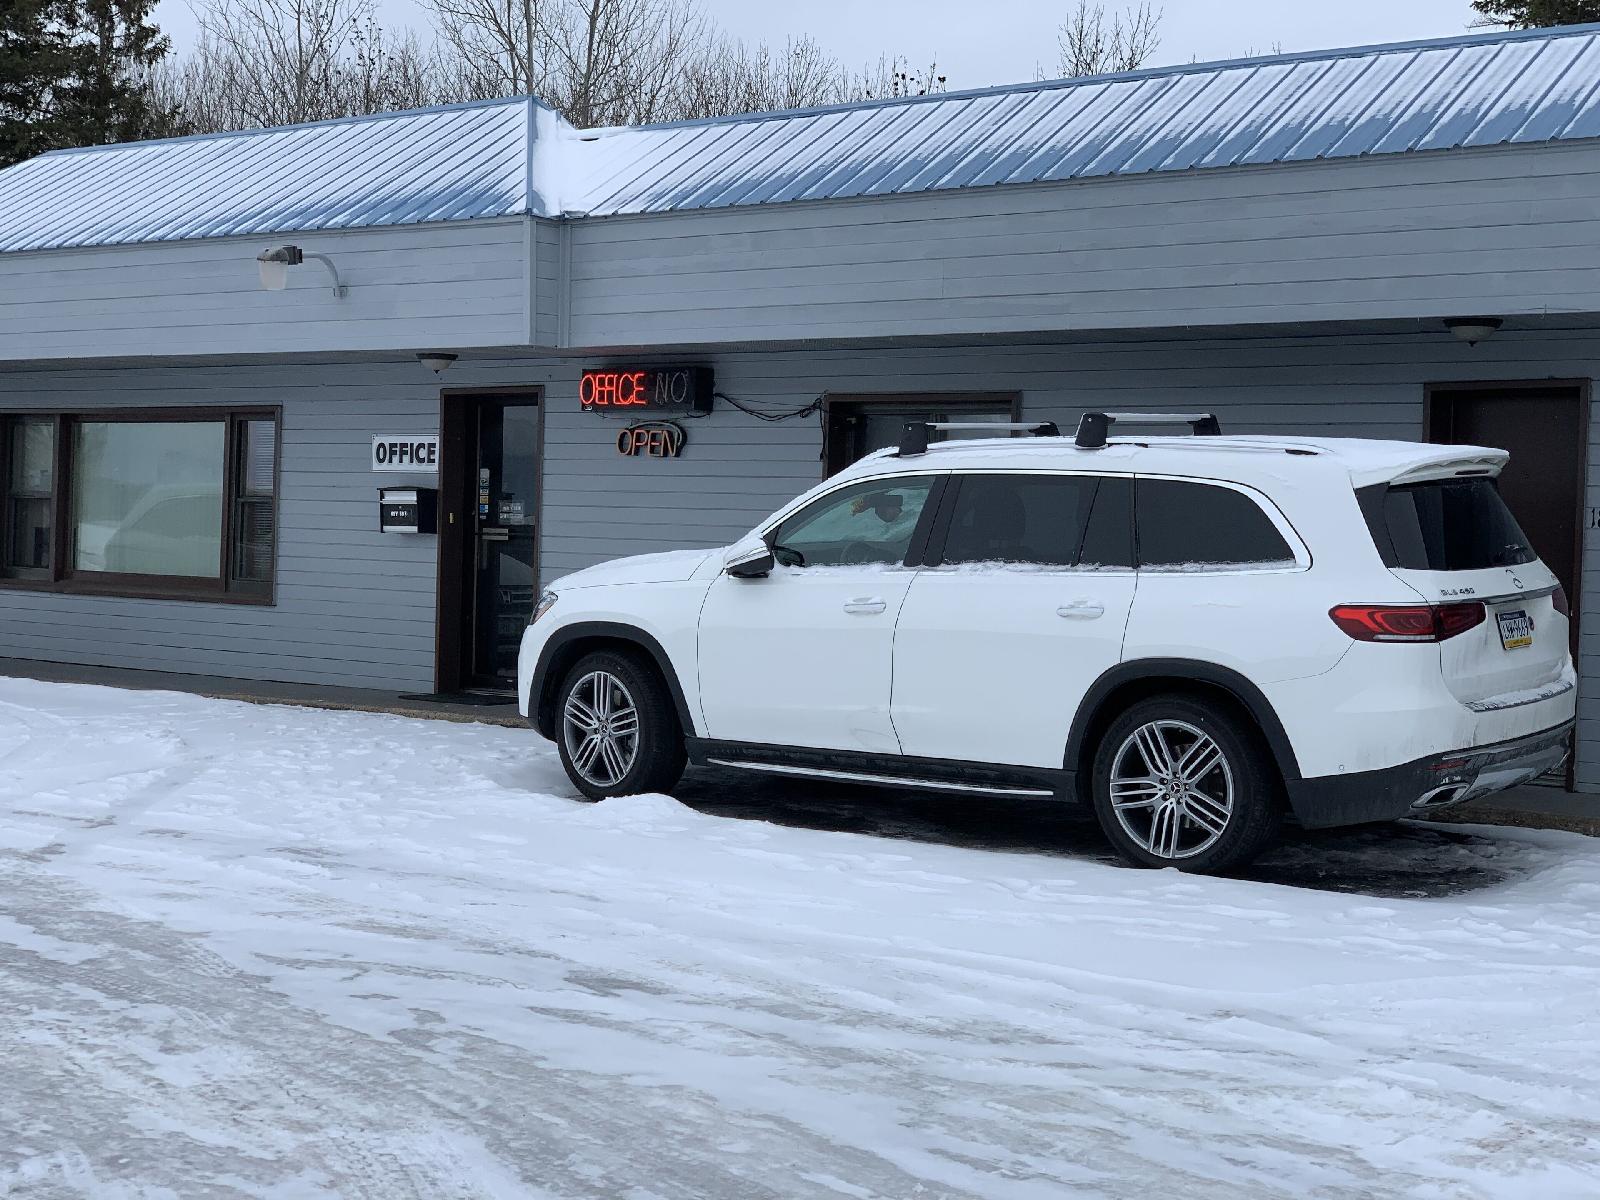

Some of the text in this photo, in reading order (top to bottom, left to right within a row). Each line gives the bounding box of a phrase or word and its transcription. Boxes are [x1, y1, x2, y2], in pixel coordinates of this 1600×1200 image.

[579, 373, 647, 405] OFFICE
[376, 442, 436, 464] OFFICE
[616, 429, 679, 457] OPEN
